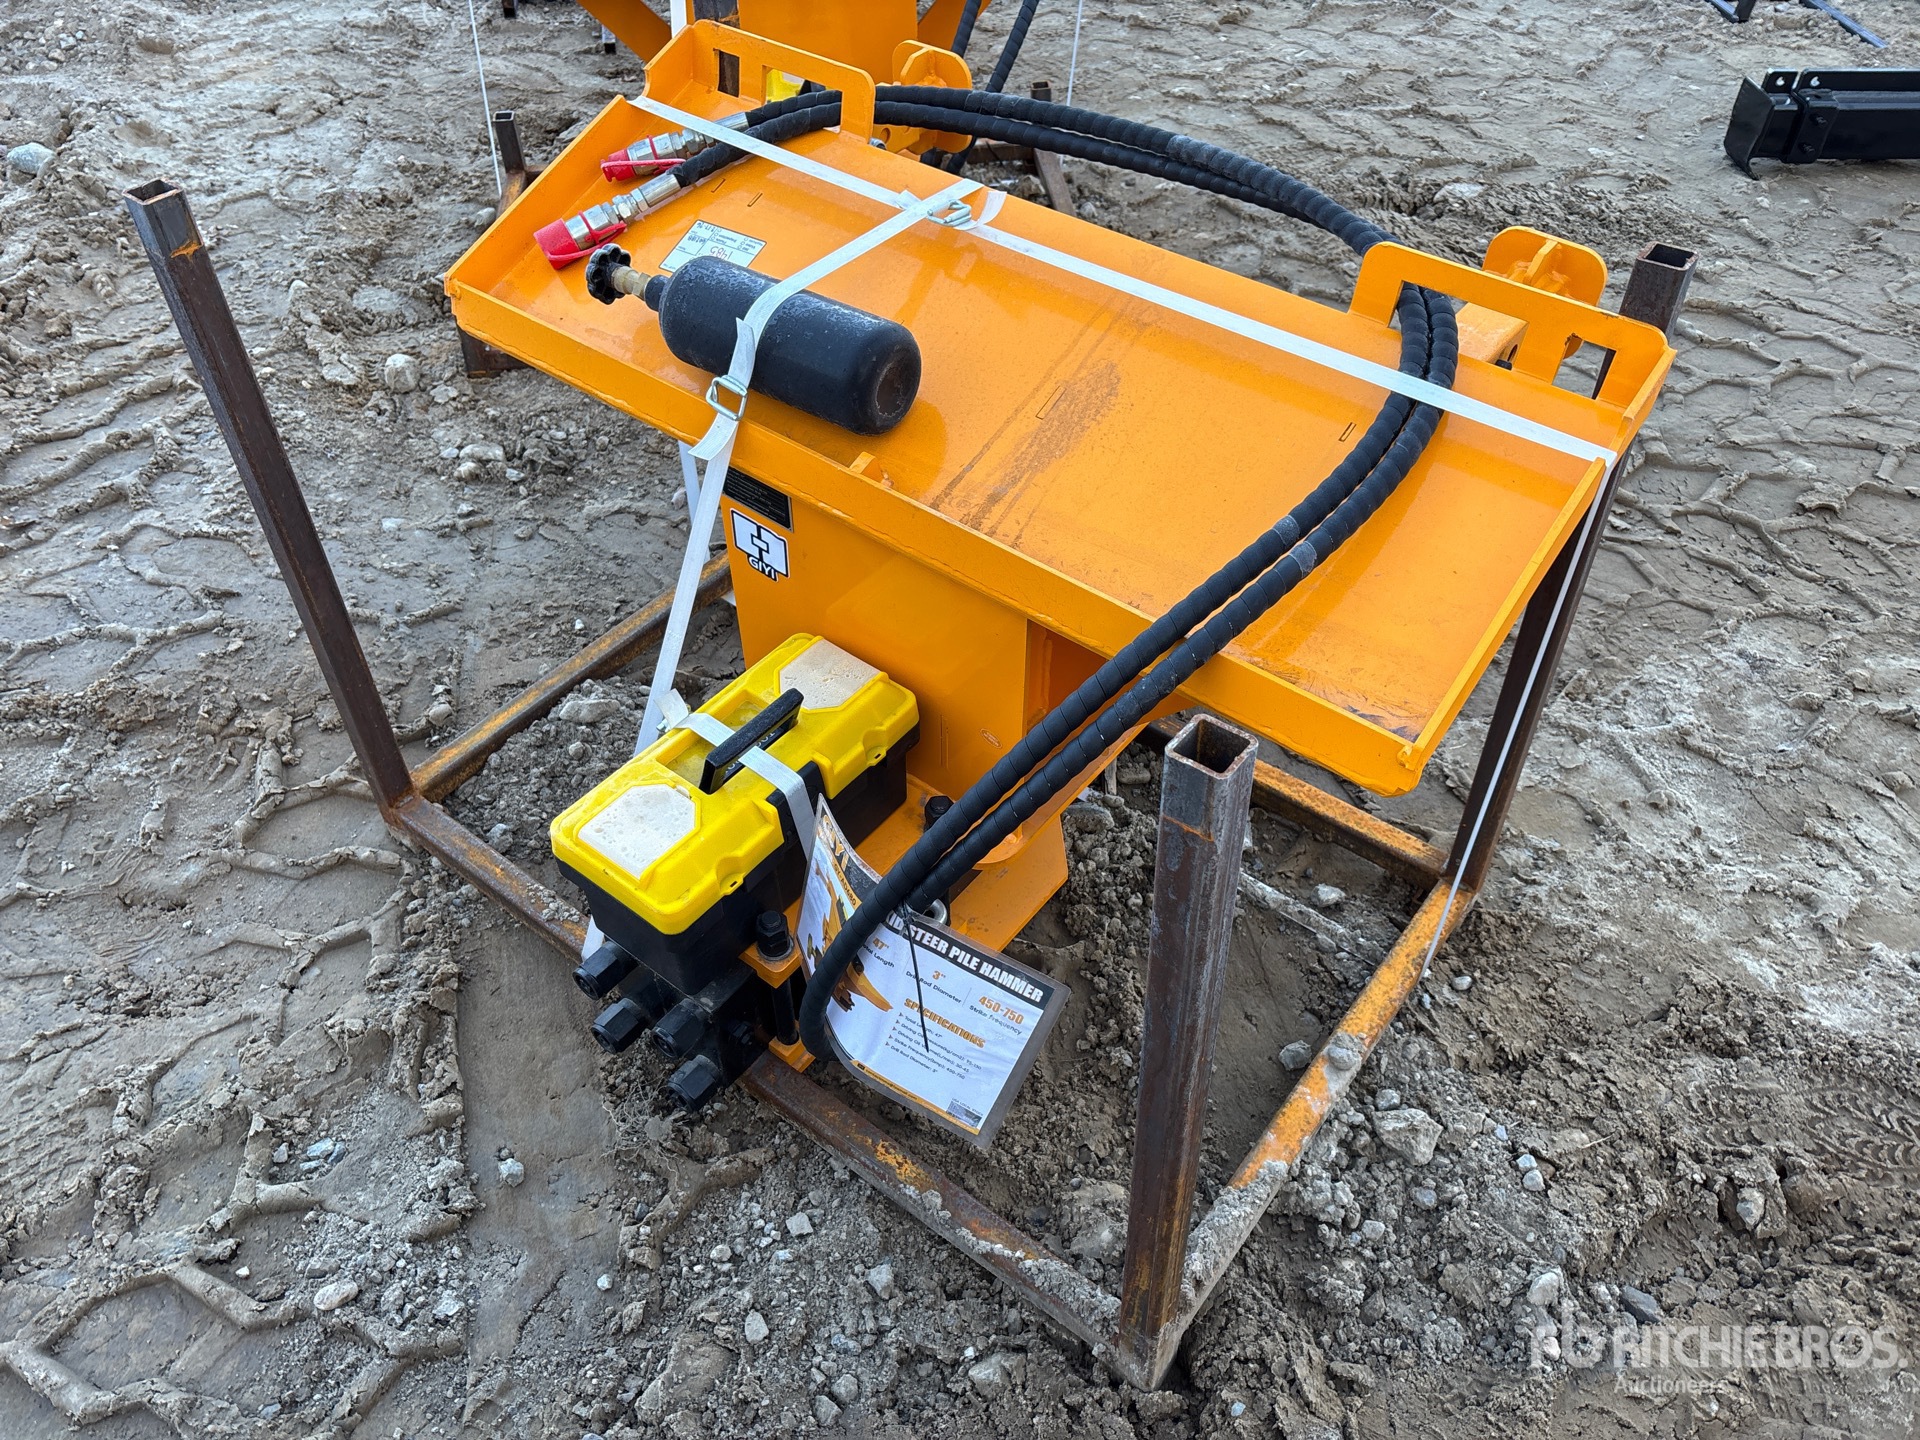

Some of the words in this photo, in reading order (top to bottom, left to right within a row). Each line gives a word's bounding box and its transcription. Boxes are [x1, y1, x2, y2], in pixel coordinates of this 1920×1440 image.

[748, 556, 776, 580] GIYI
[873, 952, 895, 968] Length
[903, 925, 950, 955] STEER
[949, 946, 980, 971] PILE
[979, 962, 1045, 1003] HAMMER
[919, 977, 933, 988] Rod
[932, 984, 962, 1004] Diameter
[969, 1005, 988, 1018] Strike
[978, 995, 1025, 1026] 450-750
